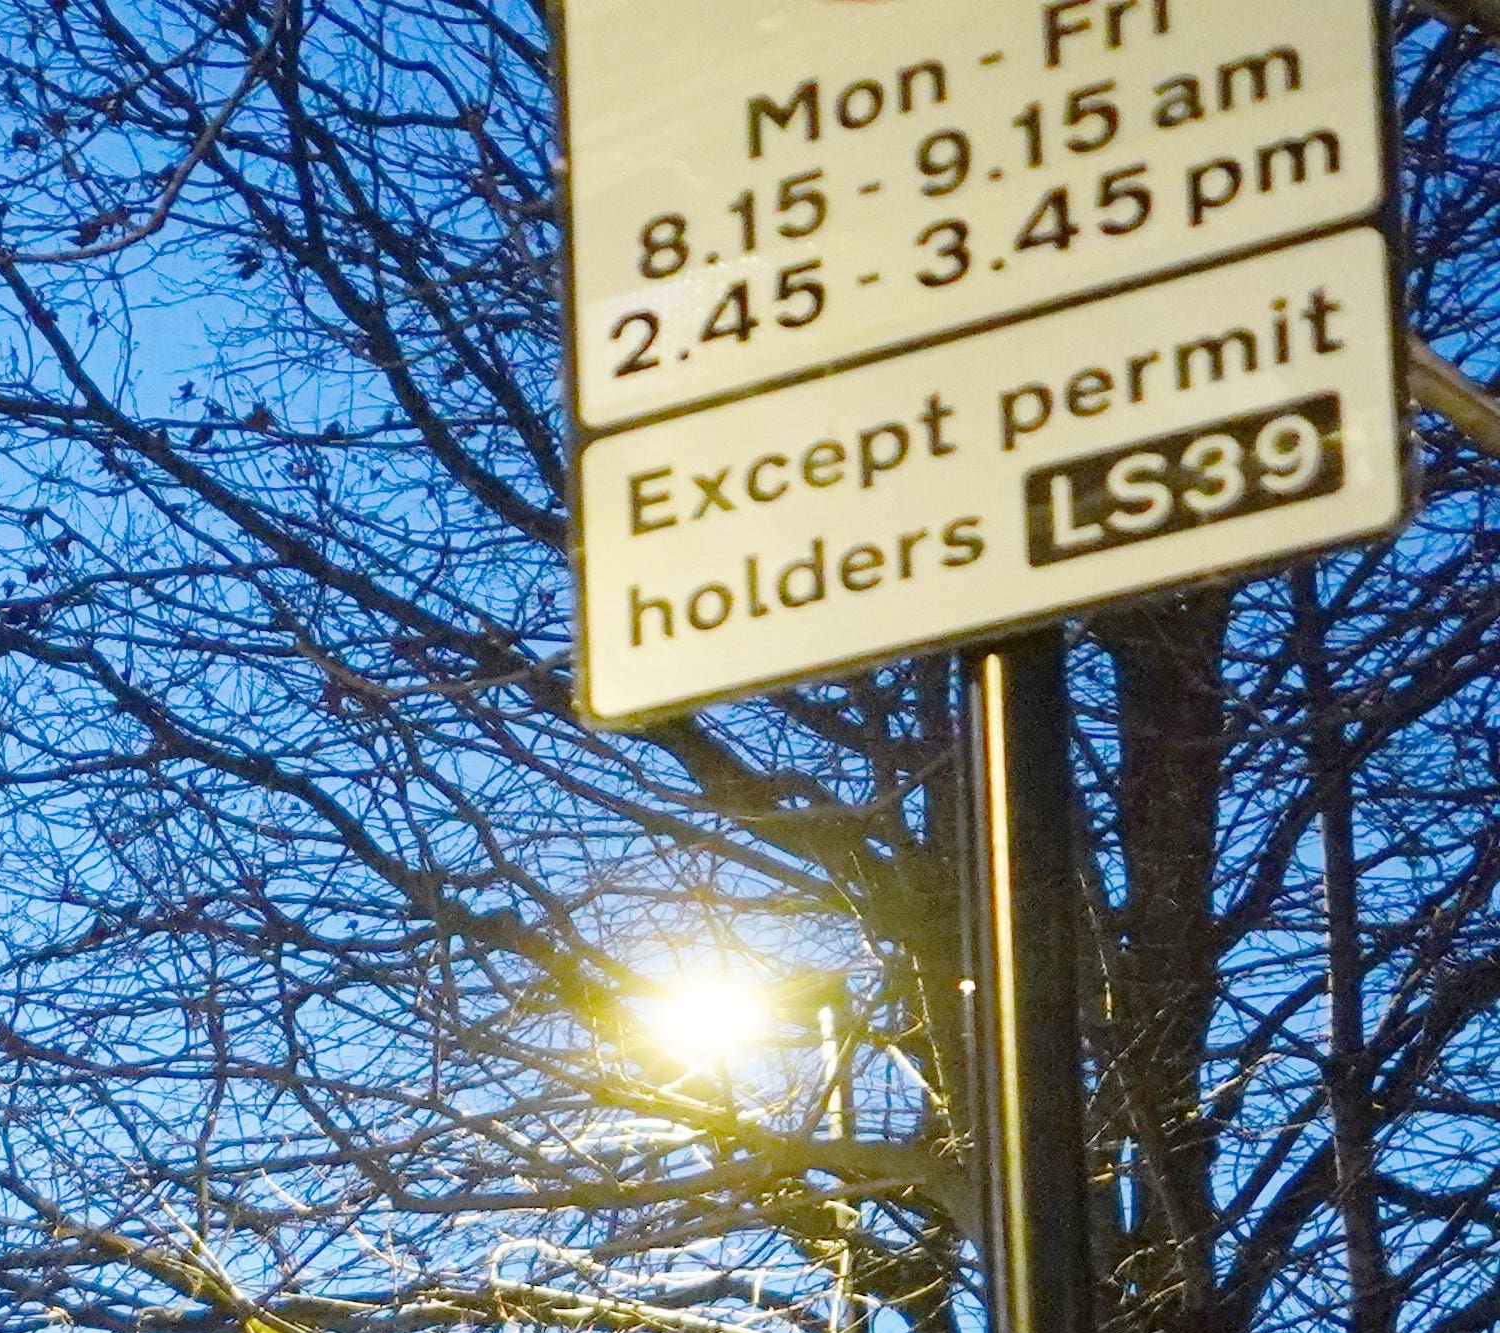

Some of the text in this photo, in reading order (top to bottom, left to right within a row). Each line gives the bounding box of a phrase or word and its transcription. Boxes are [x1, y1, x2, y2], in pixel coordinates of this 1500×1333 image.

[637, 169, 829, 281] 8.15
[916, 82, 1120, 198] 9.15
[1154, 44, 1304, 130] am
[745, 58, 947, 160] Mon
[609, 263, 827, 378] 2.45
[914, 163, 1153, 288] 3.45
[1187, 128, 1343, 227] pm
[627, 288, 1344, 536] Except permit
[627, 413, 1321, 647] holders LS39
